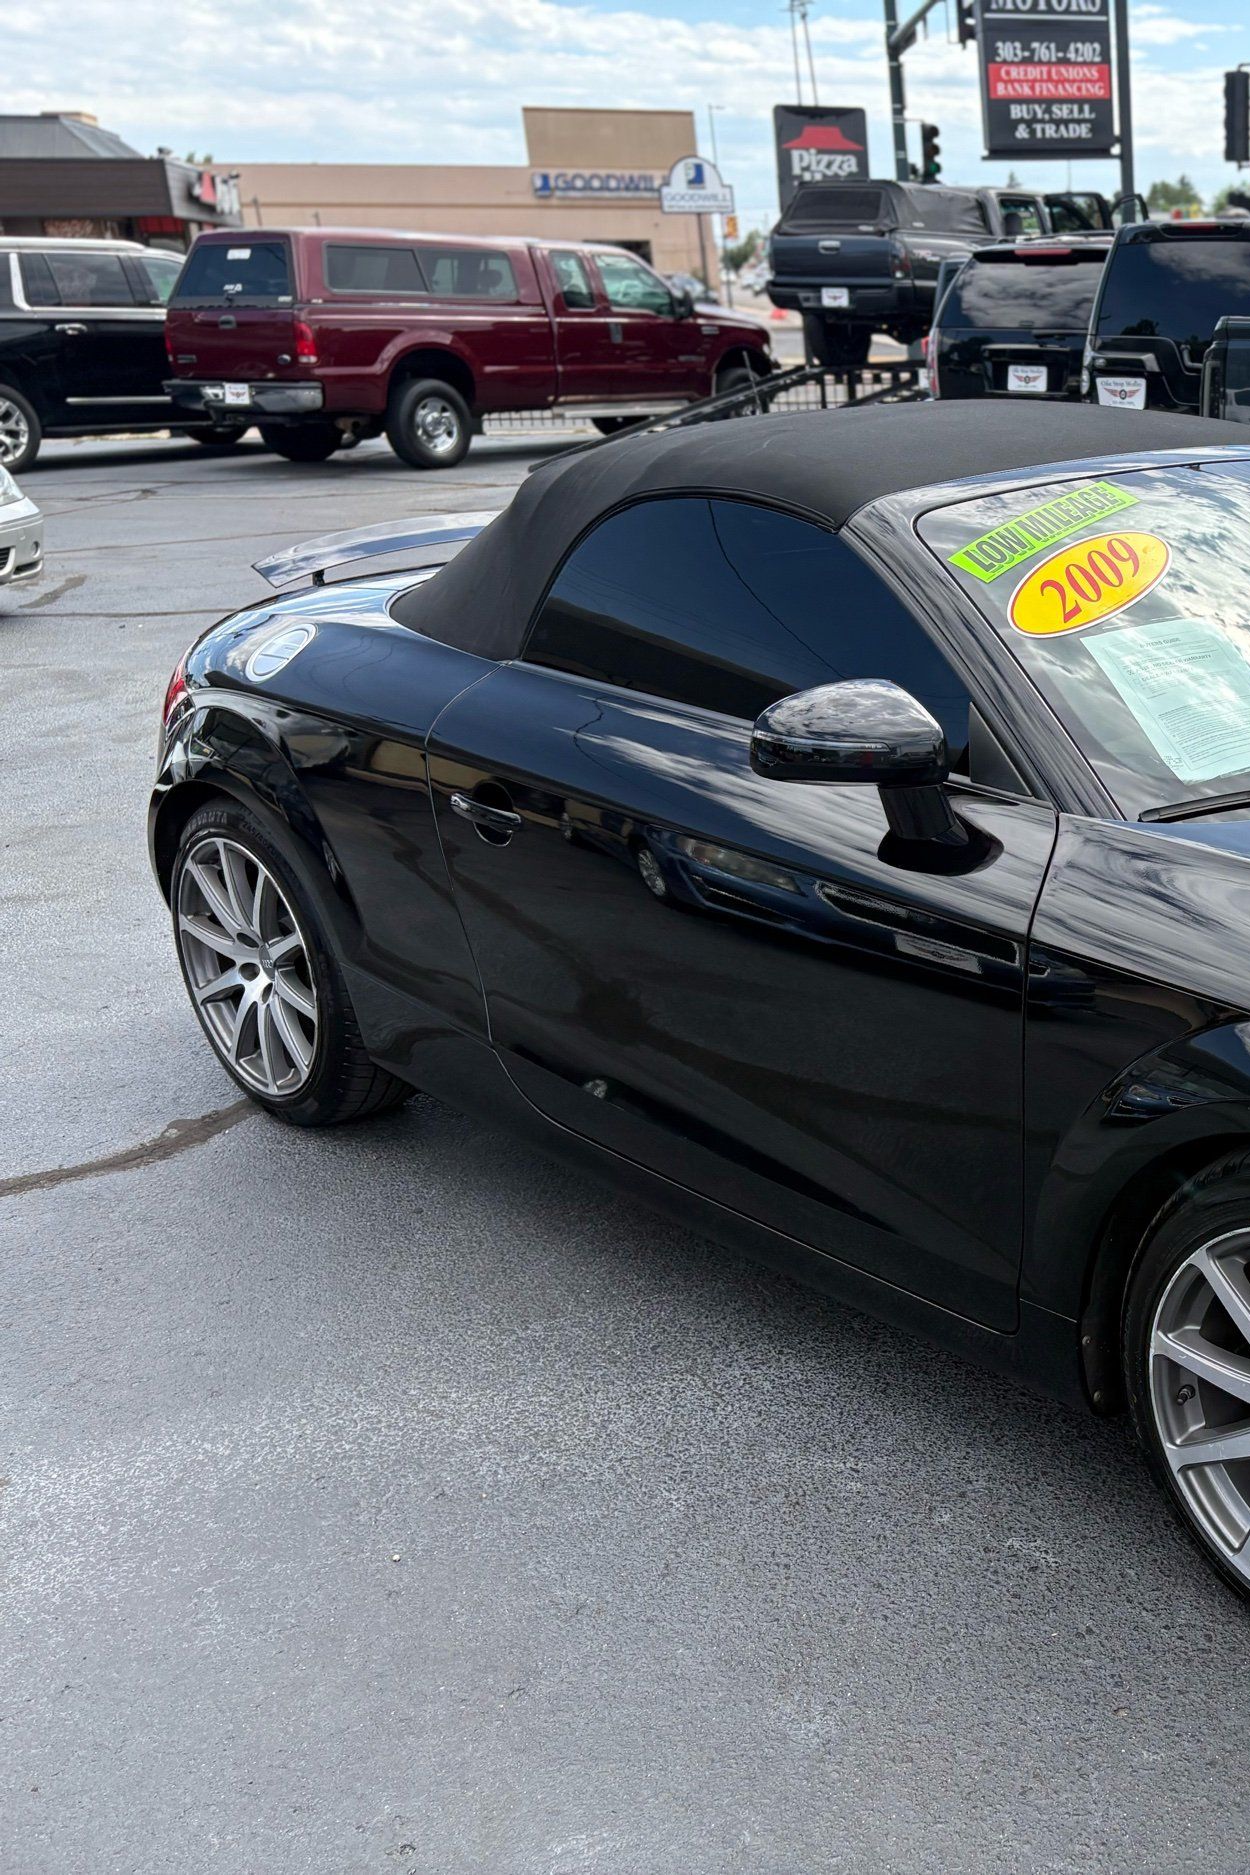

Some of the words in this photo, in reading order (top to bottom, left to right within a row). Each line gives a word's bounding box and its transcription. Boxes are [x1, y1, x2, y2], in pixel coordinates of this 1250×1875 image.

[1001, 66, 1048, 79] CREDIT
[1051, 66, 1099, 80] UNIONS
[997, 82, 1033, 95] BANK
[1035, 82, 1104, 96] FINANCING
[1010, 104, 1050, 121] BUY,
[1052, 104, 1096, 119] SELL
[1015, 123, 1030, 139] &
[1032, 123, 1092, 138] TRADE
[790, 147, 859, 177] Pizza
[554, 173, 669, 192] GOODWIL
[964, 526, 1033, 573] LOW
[1014, 486, 1120, 542] MILEAGE
[1040, 537, 1140, 624] 2009
